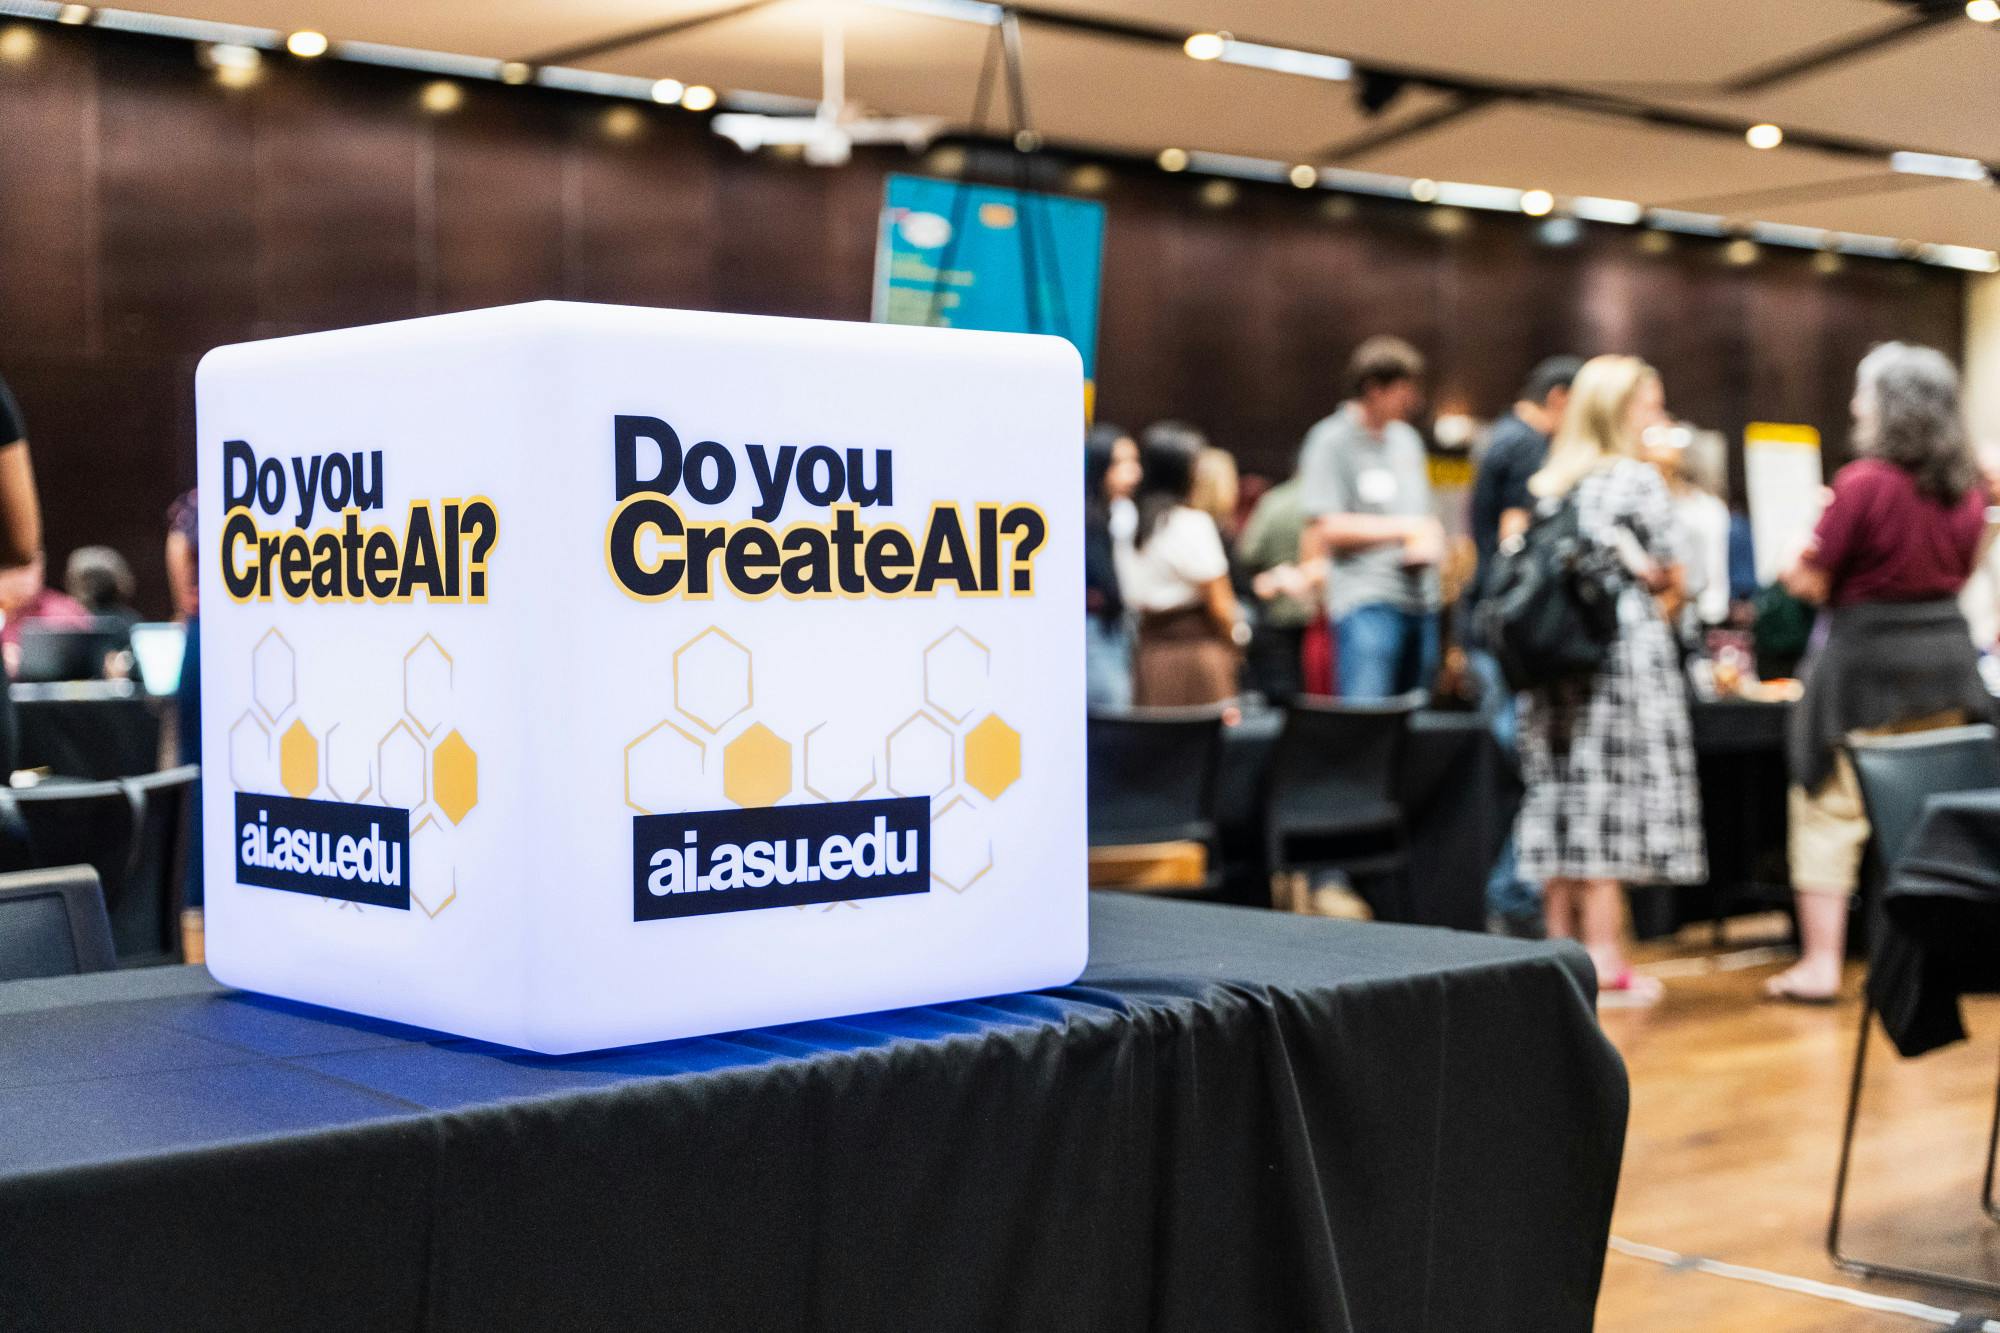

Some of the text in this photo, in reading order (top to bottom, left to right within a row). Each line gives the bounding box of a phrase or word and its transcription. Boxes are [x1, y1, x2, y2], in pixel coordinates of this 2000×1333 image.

[223, 440, 384, 529] Do you
[614, 414, 893, 523] Do you
[222, 501, 497, 598] CreateAI?
[610, 499, 1046, 597] CreateAI?
[241, 809, 401, 887] ai.asu.edu
[647, 815, 918, 897] ai.asu.edu
